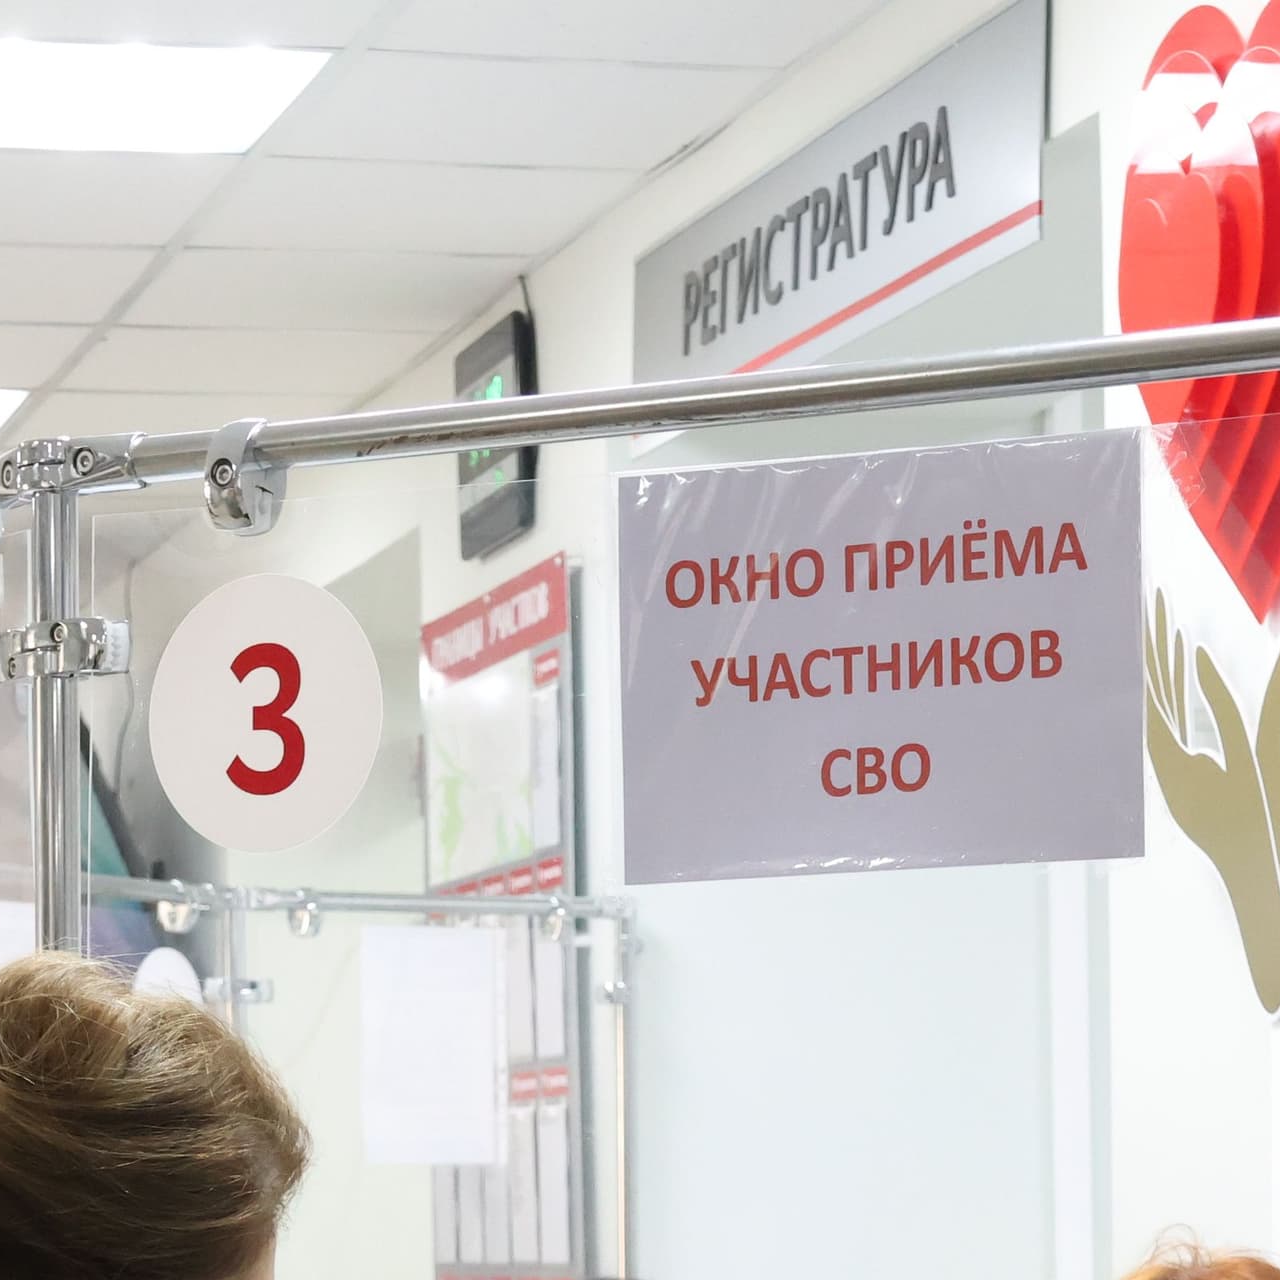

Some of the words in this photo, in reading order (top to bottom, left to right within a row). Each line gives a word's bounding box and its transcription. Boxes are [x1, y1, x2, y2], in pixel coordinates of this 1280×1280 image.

[683, 105, 956, 356] РЕГИСТРАТУРА
[665, 548, 825, 608] ОКНО
[844, 519, 1088, 592] ПРИЁМА
[690, 630, 1063, 707] УЧАСТНИКОВ
[226, 642, 305, 796] 3
[821, 743, 931, 797] СВО
